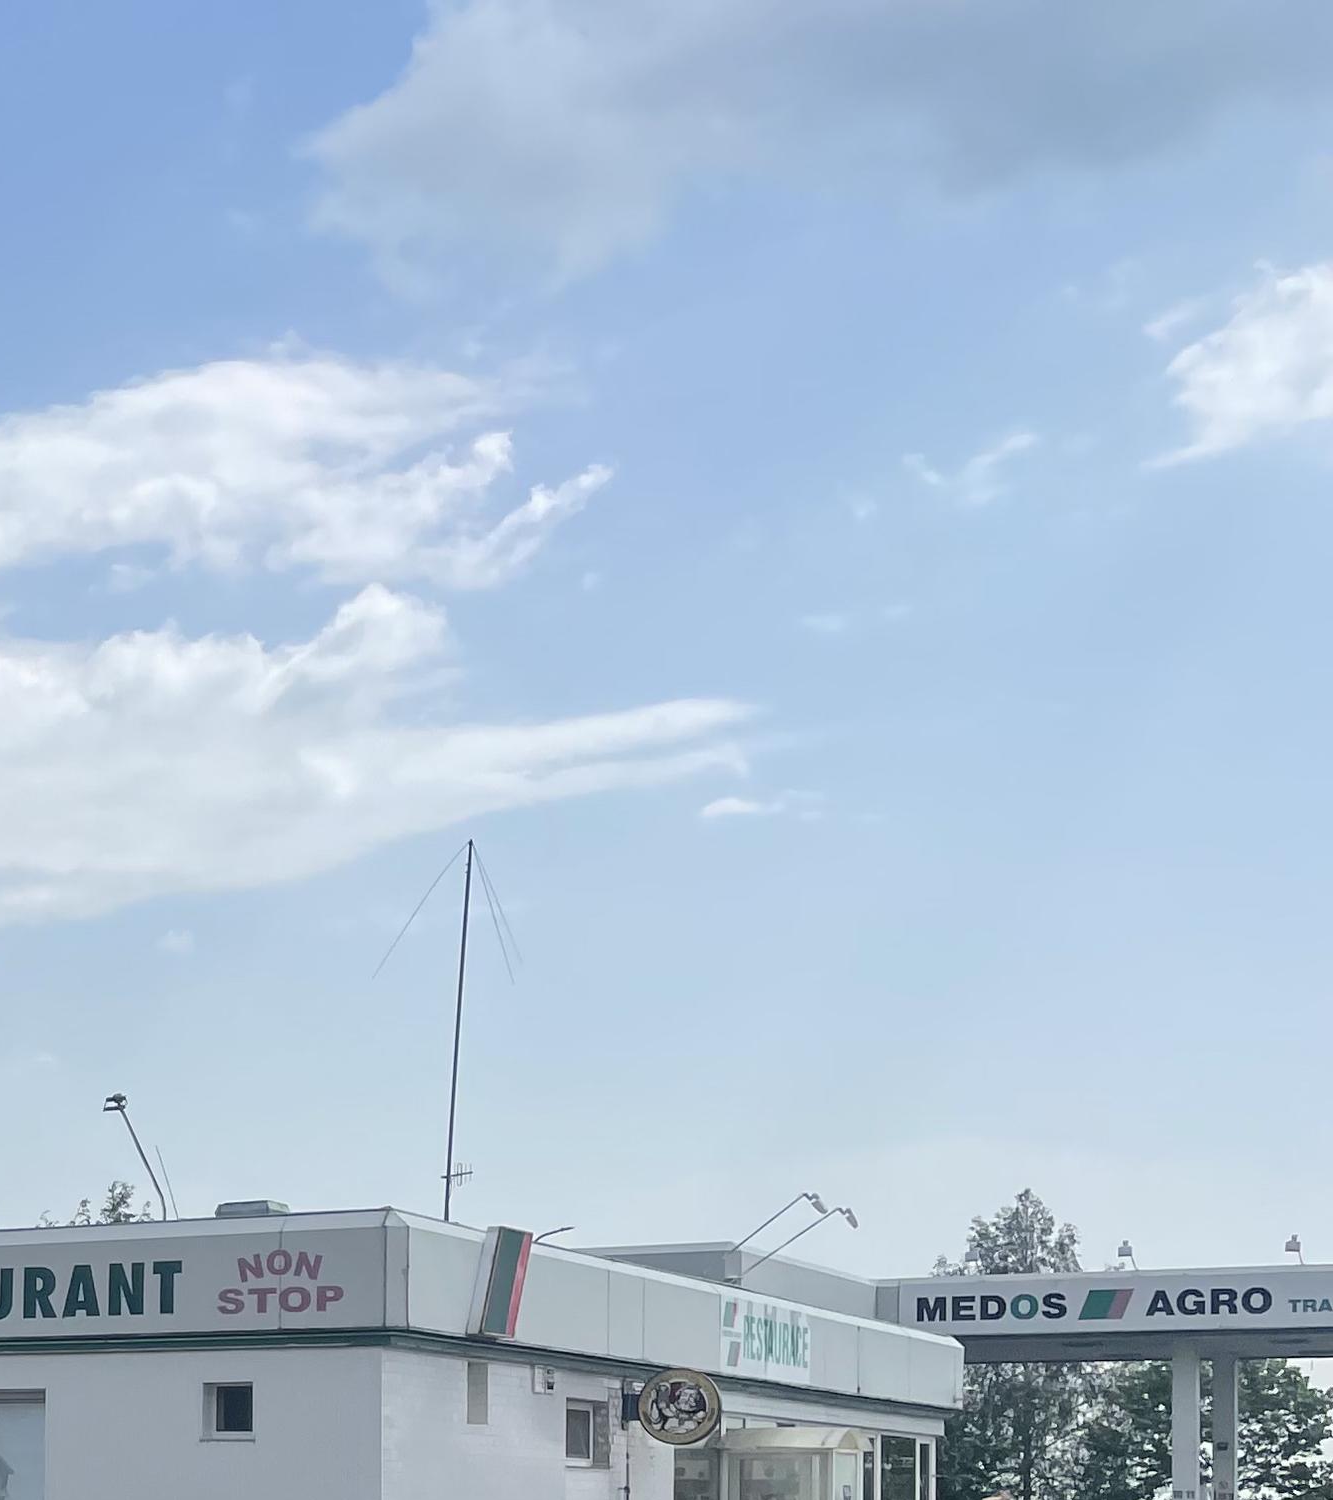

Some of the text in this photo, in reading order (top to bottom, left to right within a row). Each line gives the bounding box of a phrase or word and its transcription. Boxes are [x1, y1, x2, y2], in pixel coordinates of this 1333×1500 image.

[236, 1249, 324, 1283] NON
[217, 1285, 345, 1315] STOP
[916, 1293, 1067, 1322] MEDOS
[1145, 1287, 1273, 1316] AGRO
